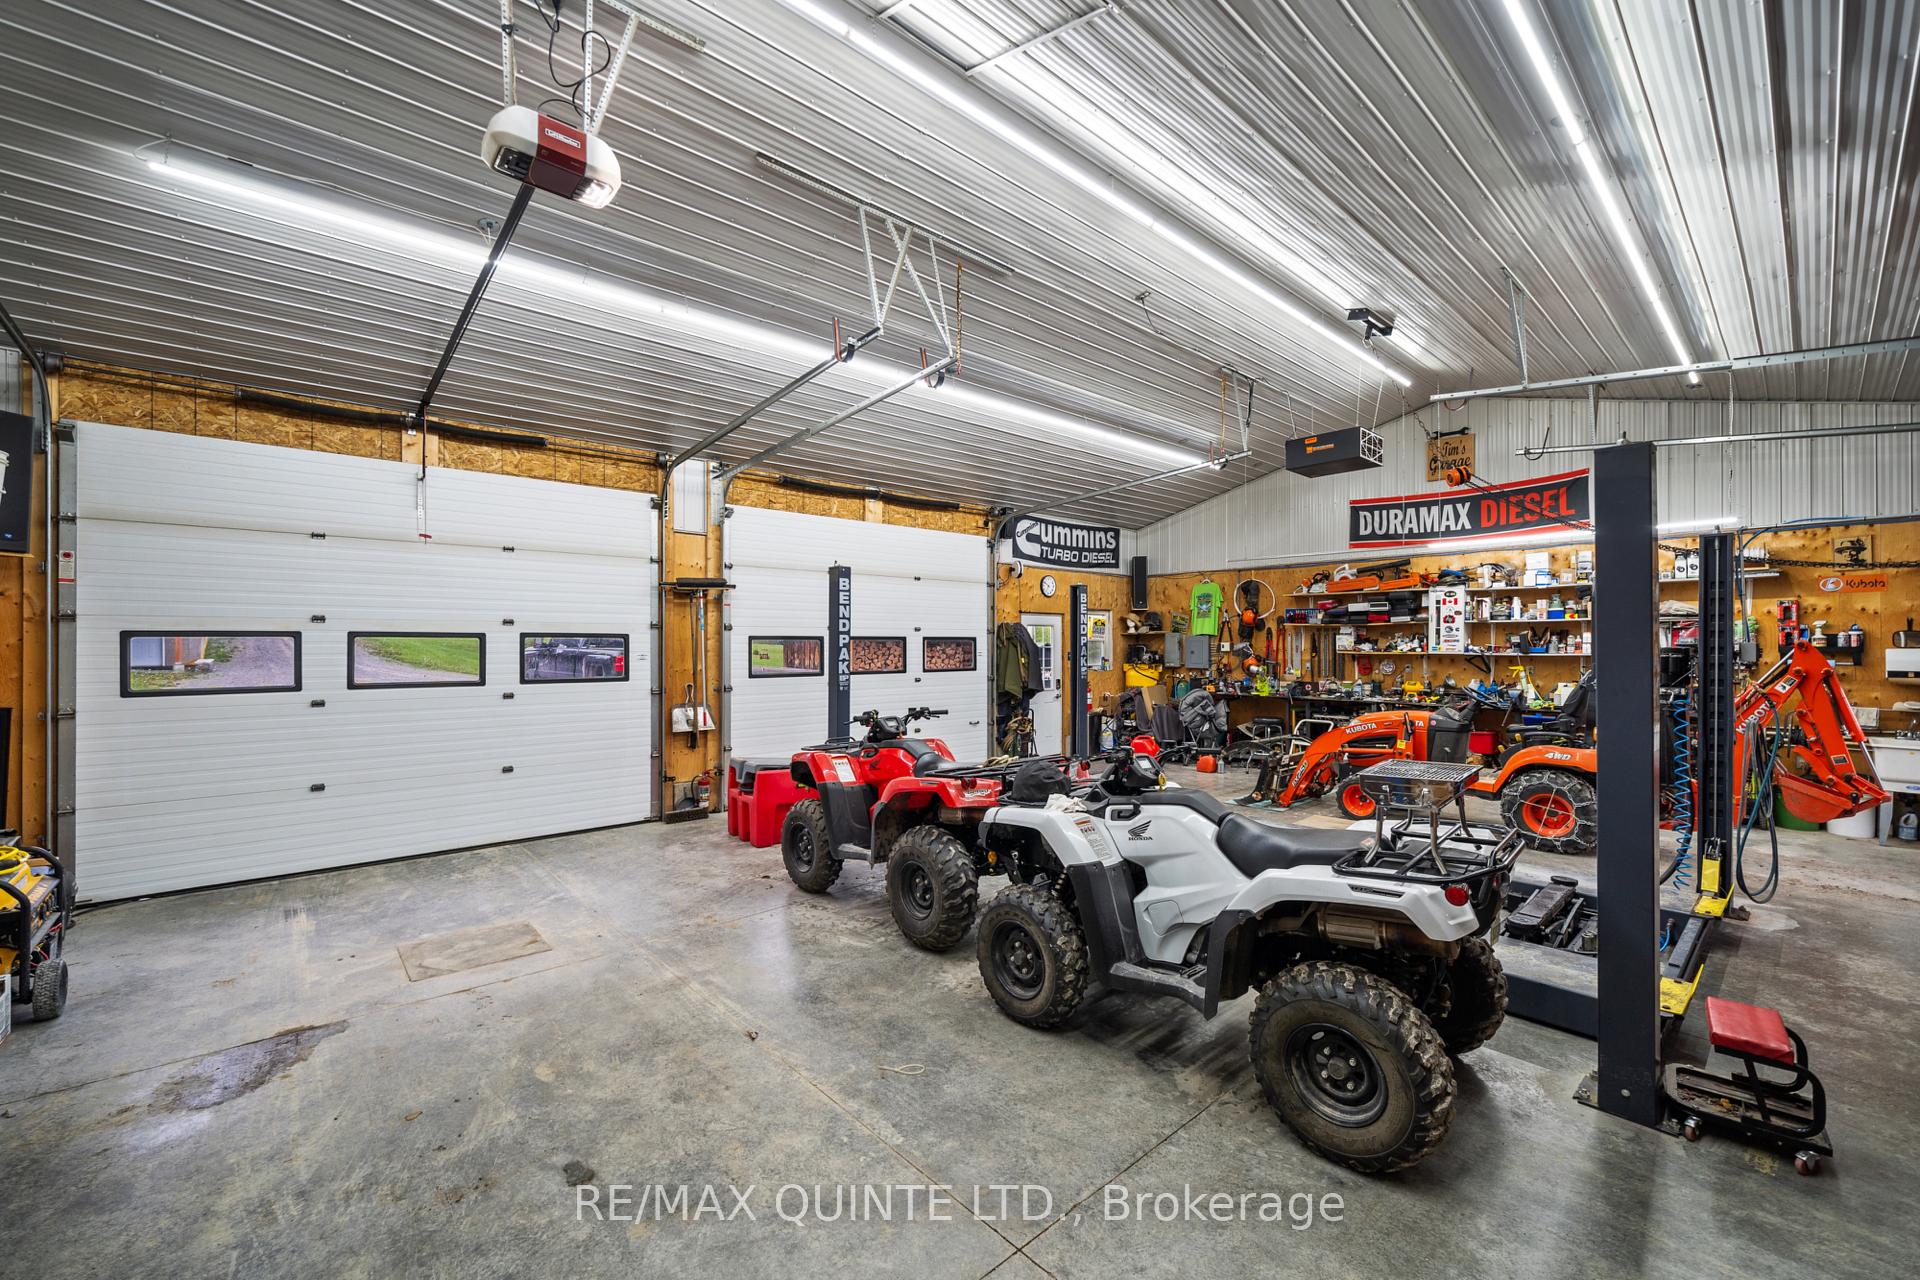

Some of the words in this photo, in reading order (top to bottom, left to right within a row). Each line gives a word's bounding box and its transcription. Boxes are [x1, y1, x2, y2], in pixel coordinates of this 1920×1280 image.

[1441, 440, 1466, 457] Tim's
[1359, 502, 1472, 536] DURAMAX
[1480, 486, 1576, 529] DIESEL
[1041, 546, 1079, 563] TURBO
[1081, 551, 1116, 564] DIESEL
[1845, 579, 1886, 589] Kubota
[1345, 722, 1377, 734] KUBOTA
